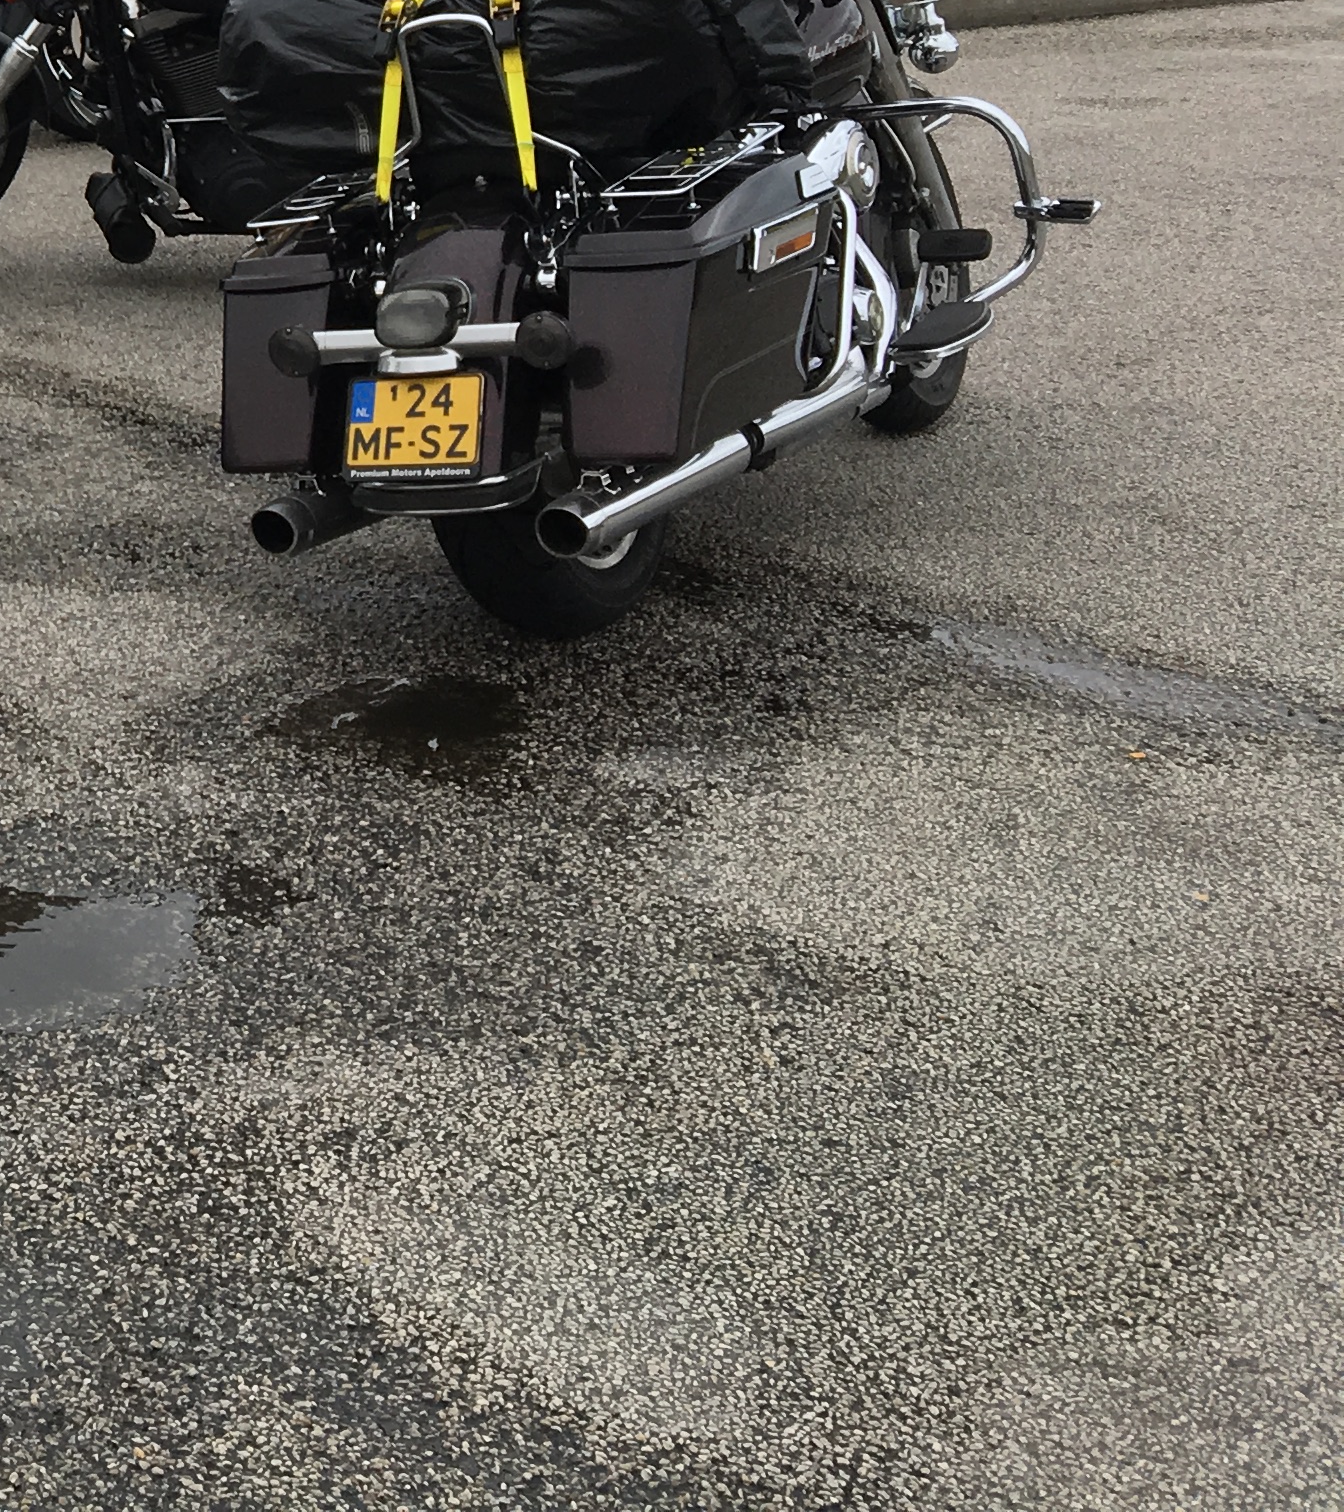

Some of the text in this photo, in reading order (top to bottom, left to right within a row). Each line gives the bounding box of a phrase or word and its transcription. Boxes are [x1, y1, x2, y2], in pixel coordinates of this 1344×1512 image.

[355, 407, 370, 418] NL
[350, 467, 471, 478] Premium Motors Apeldoorn
